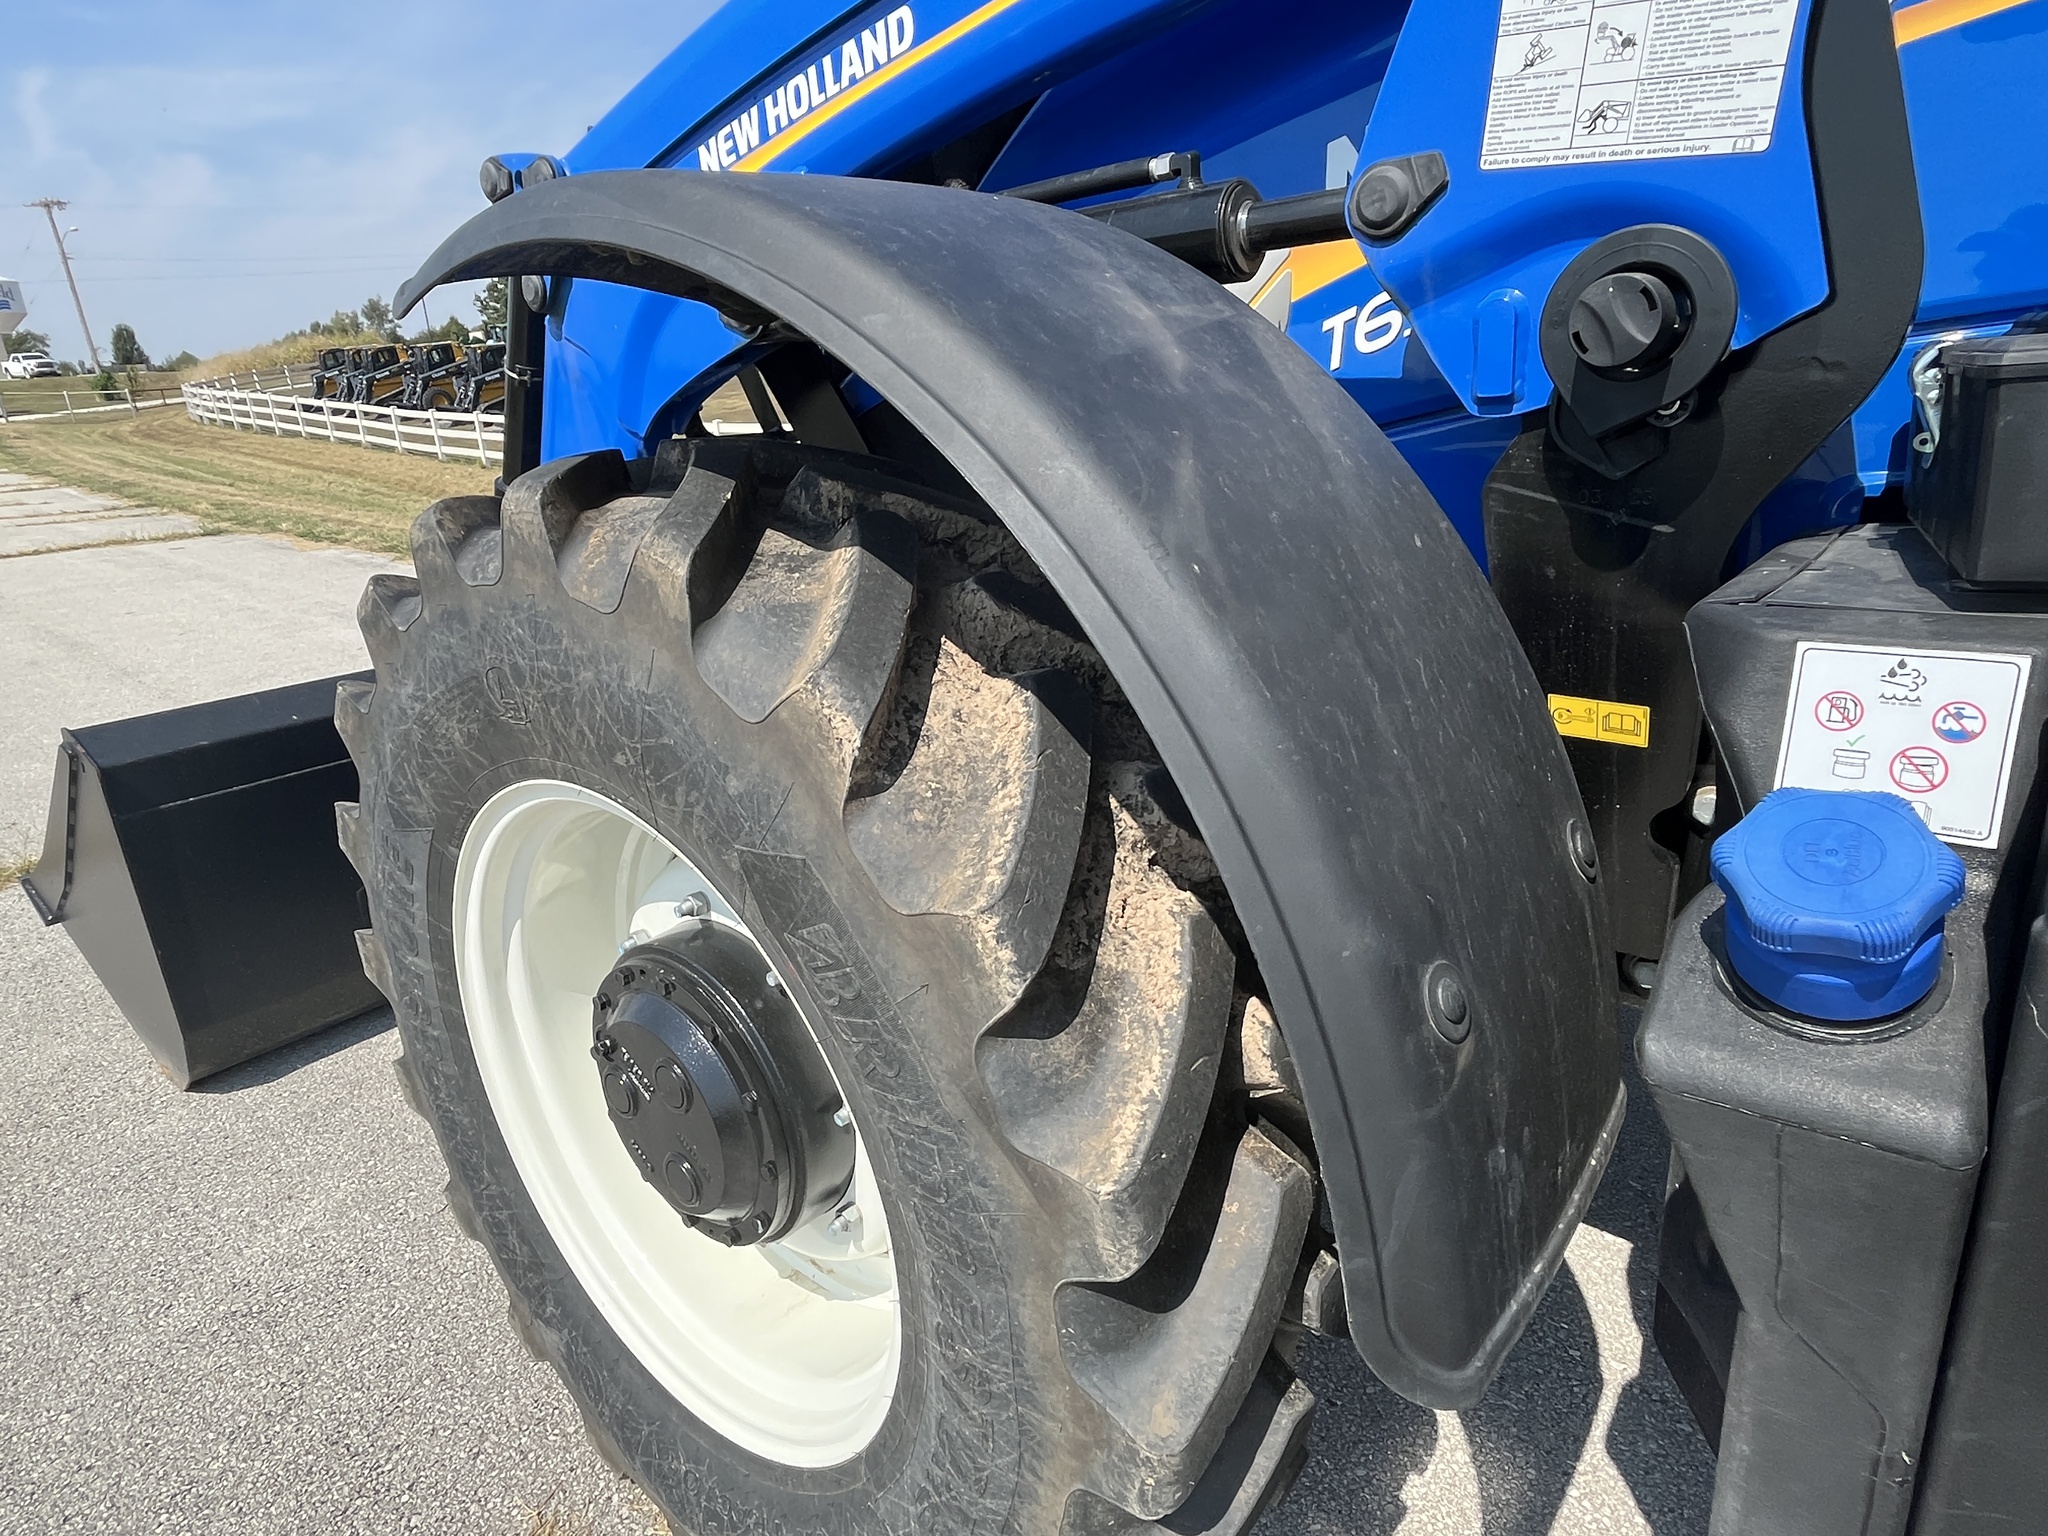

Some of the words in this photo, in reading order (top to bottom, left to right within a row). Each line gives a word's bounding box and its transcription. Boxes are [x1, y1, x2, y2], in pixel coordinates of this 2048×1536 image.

[698, 103, 760, 171] NEW
[764, 4, 915, 136] HOLLAND
[1483, 157, 1509, 165] Failure
[1520, 154, 1550, 164] comply
[1552, 153, 1570, 162] may
[1571, 151, 1596, 159] result
[1597, 150, 1606, 158] in
[1608, 148, 1633, 157] death
[1634, 147, 1644, 155] or
[1646, 145, 1680, 154] serious
[1682, 142, 1712, 153] injury.
